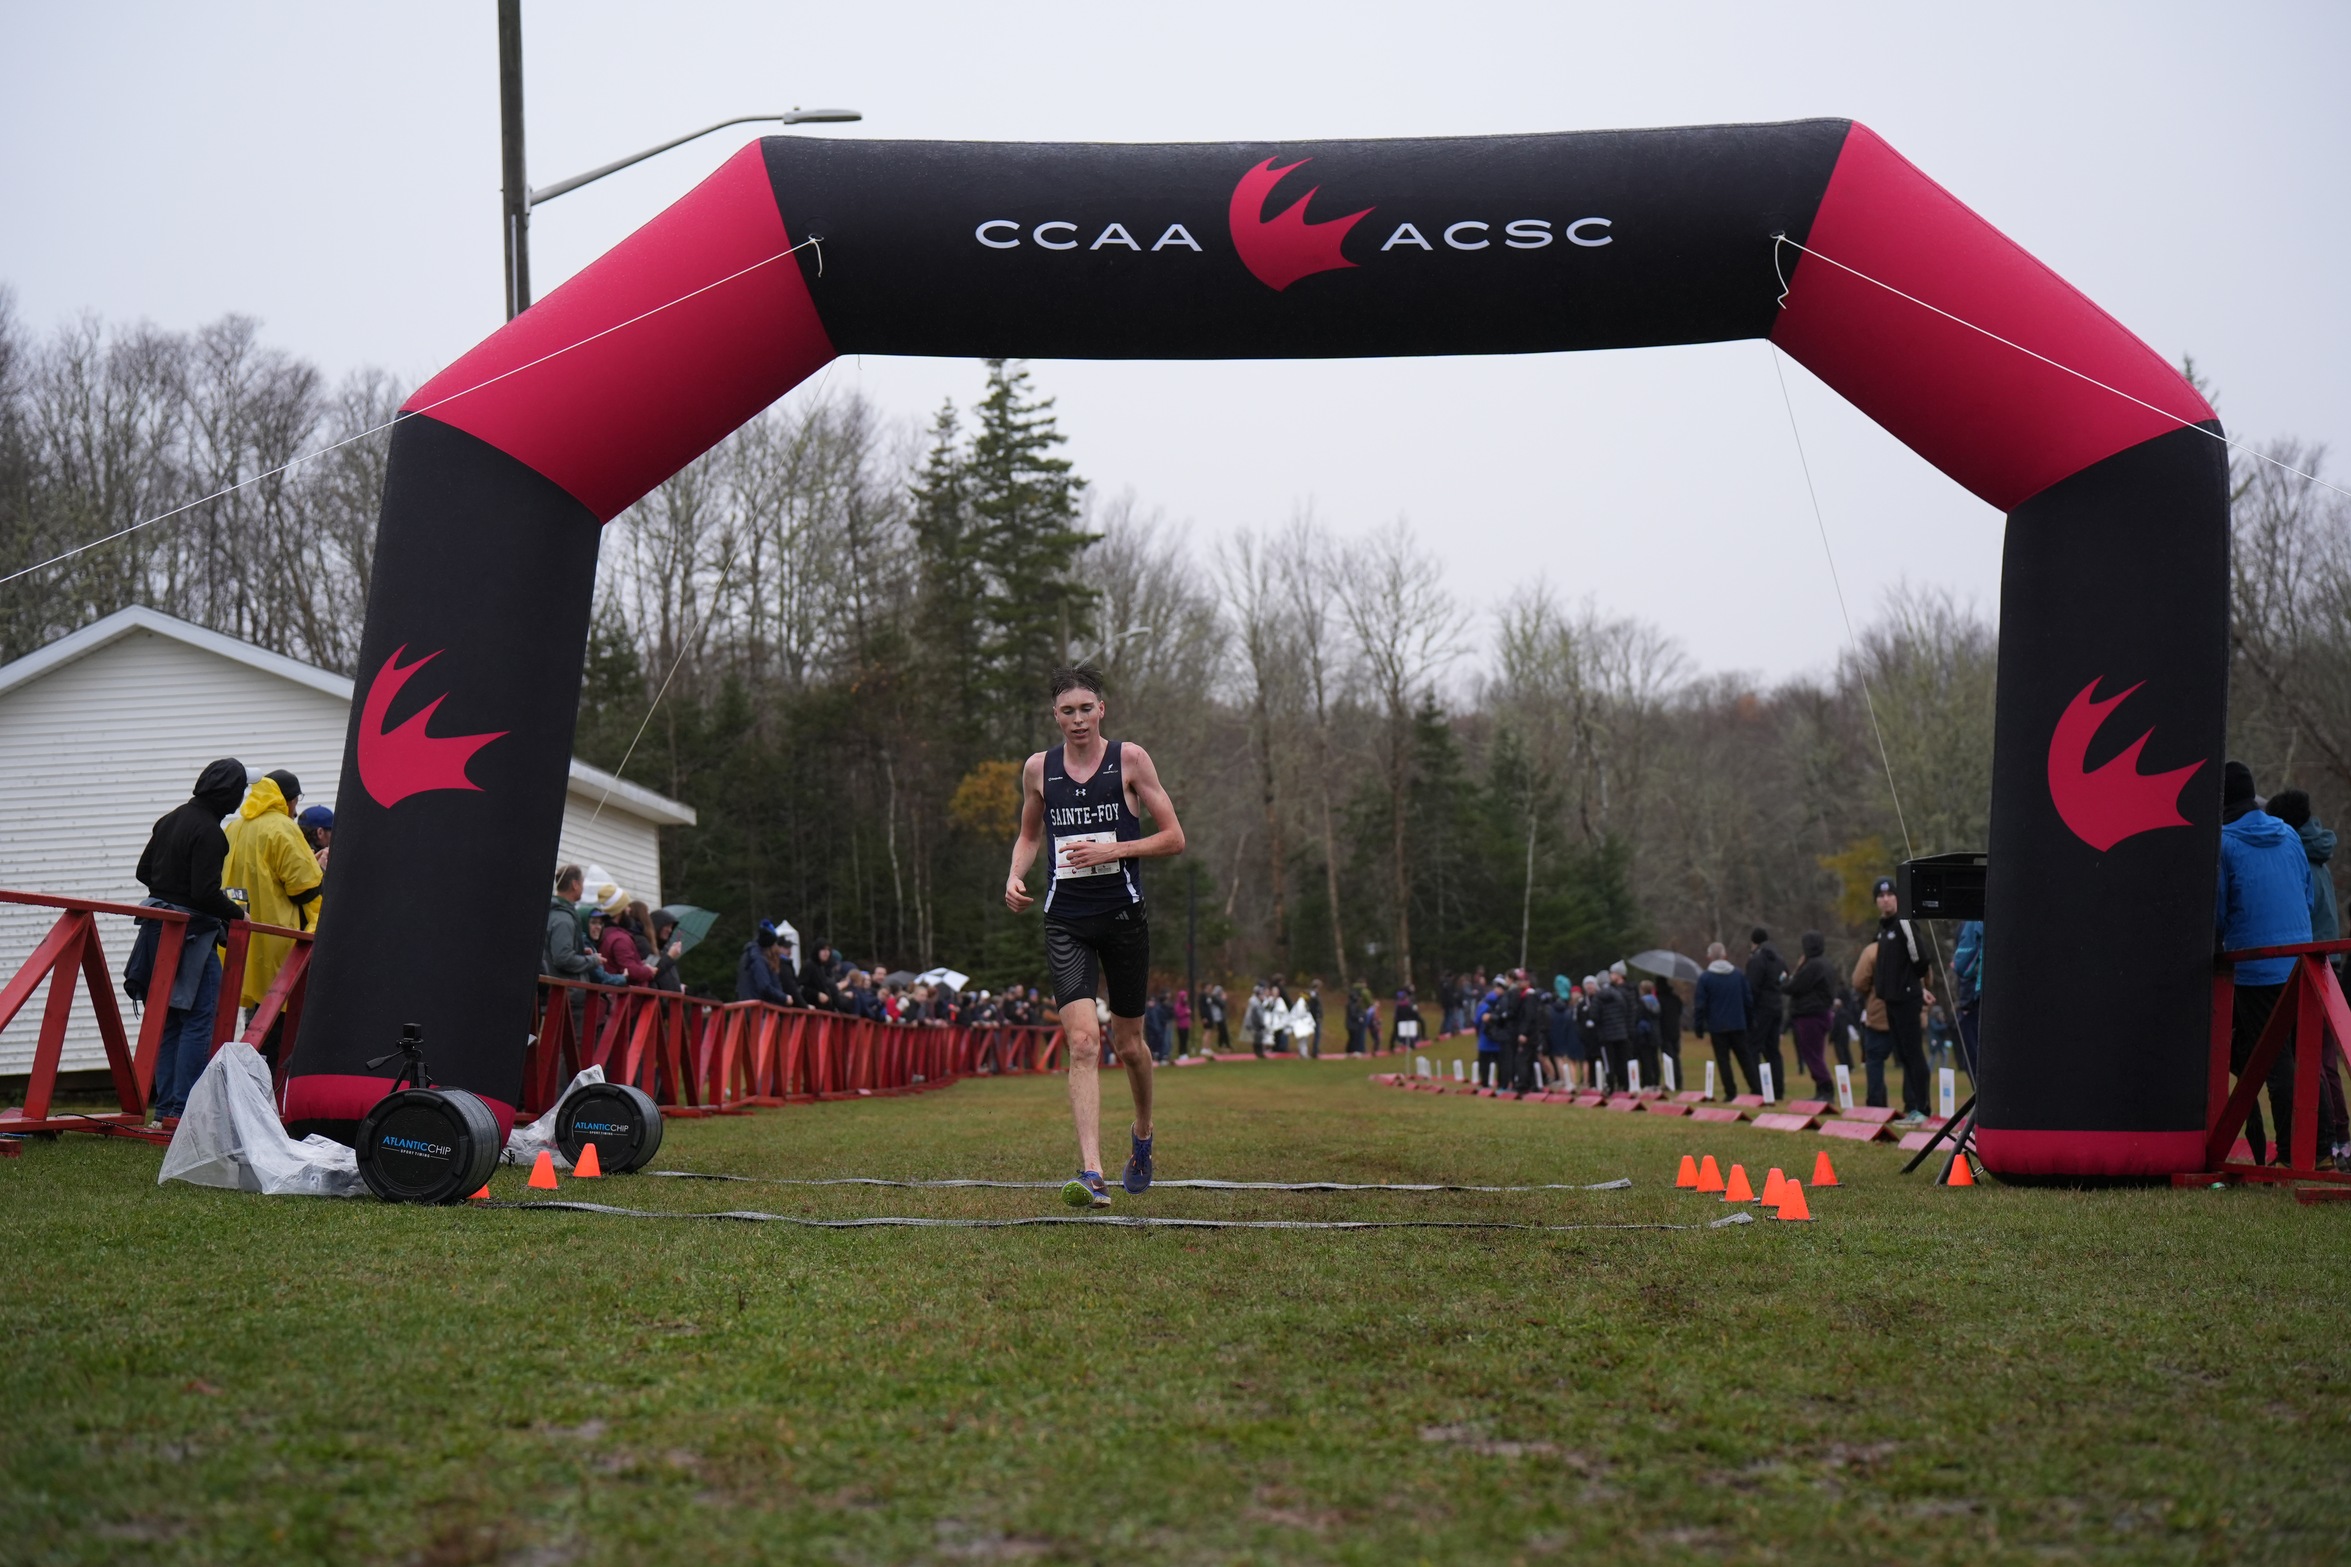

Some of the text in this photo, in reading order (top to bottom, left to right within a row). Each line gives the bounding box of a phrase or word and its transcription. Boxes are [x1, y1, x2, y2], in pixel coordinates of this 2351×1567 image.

[975, 217, 1613, 251] CCAA ACSC
[1050, 803, 1119, 826] SAINTE-FOY
[575, 1121, 629, 1132] ATLANTICCHIP
[383, 1135, 452, 1155] ATLANTICCHIP
